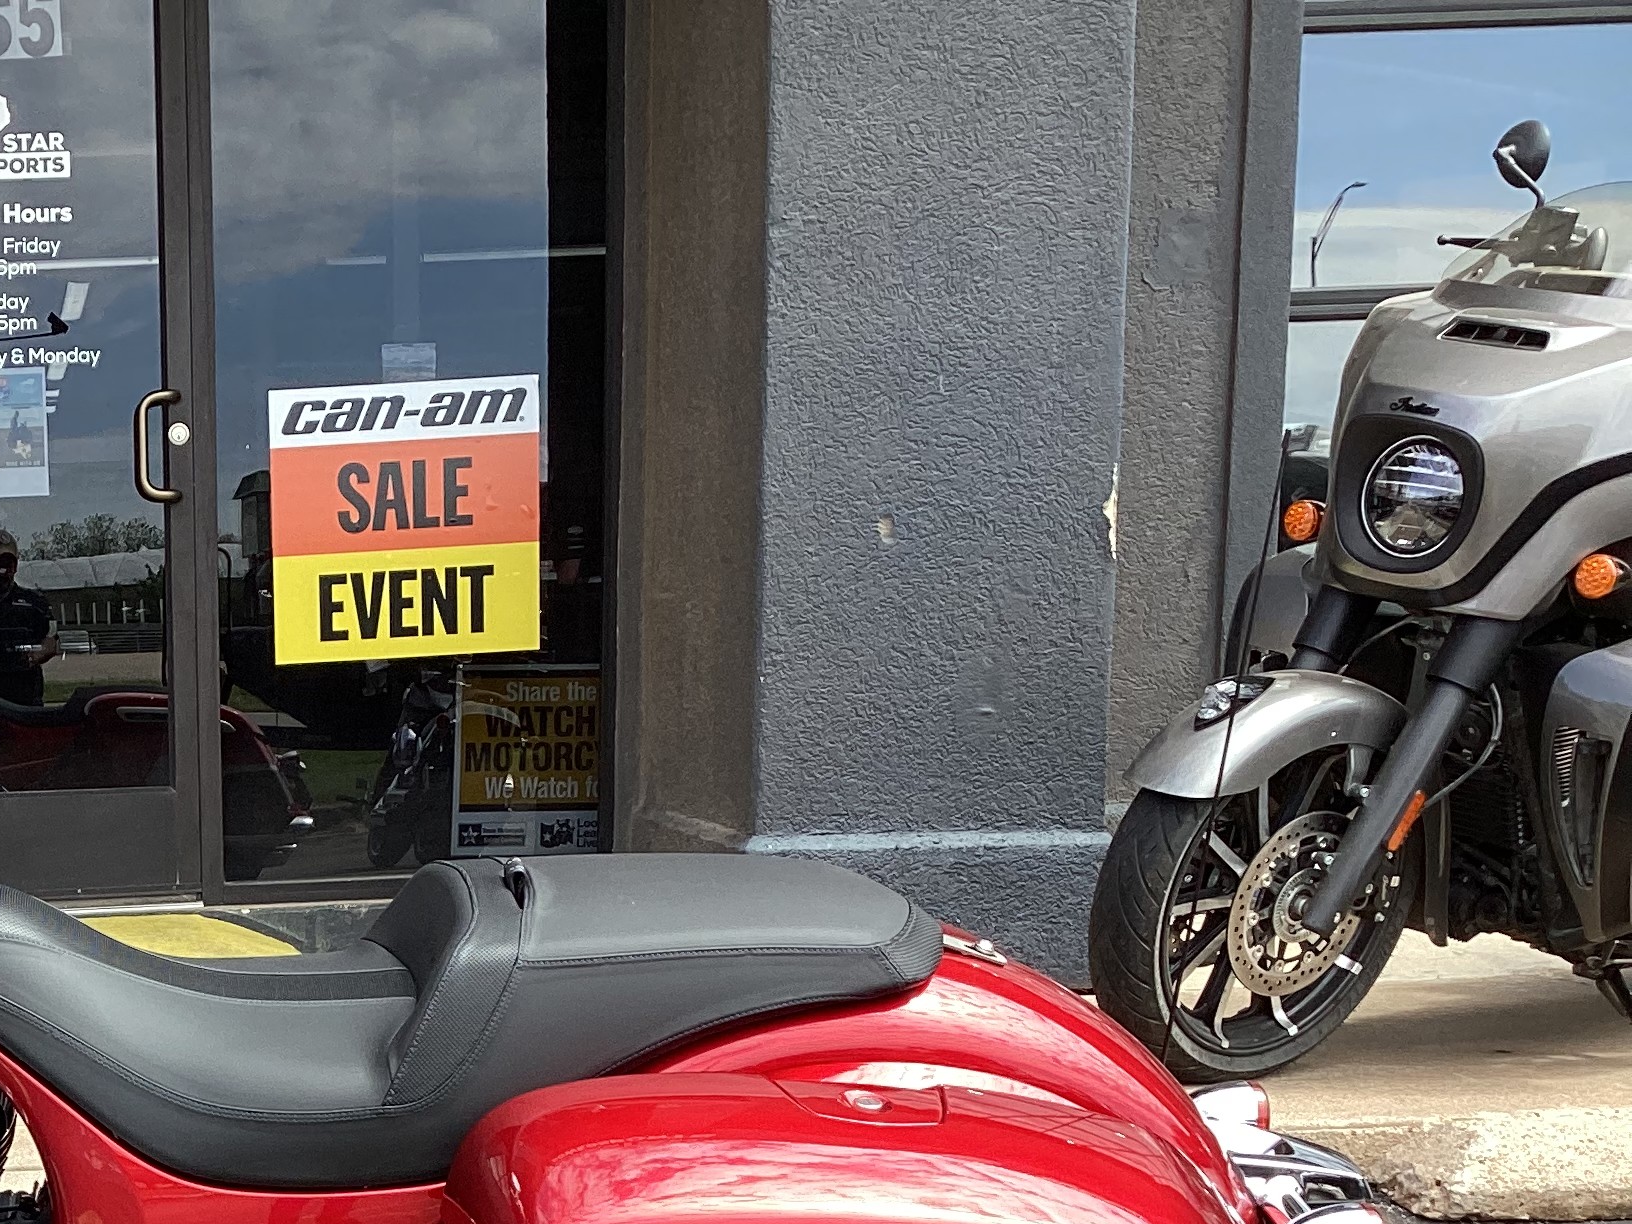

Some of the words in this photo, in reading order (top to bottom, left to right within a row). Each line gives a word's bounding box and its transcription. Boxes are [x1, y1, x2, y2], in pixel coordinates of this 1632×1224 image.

[3, 132, 65, 153] STAR
[3, 203, 73, 225] Hours
[3, 237, 61, 258] Friday
[11, 349, 25, 364] &
[28, 347, 101, 368] Monday
[282, 387, 527, 436] can-am
[337, 456, 474, 534] SALE
[319, 565, 495, 643] EVENT
[506, 681, 561, 702] Share
[568, 682, 597, 702] the
[485, 705, 596, 737] WATCH
[465, 741, 598, 773] MOTORC
[485, 775, 515, 799] We
[520, 776, 578, 799] Watch
